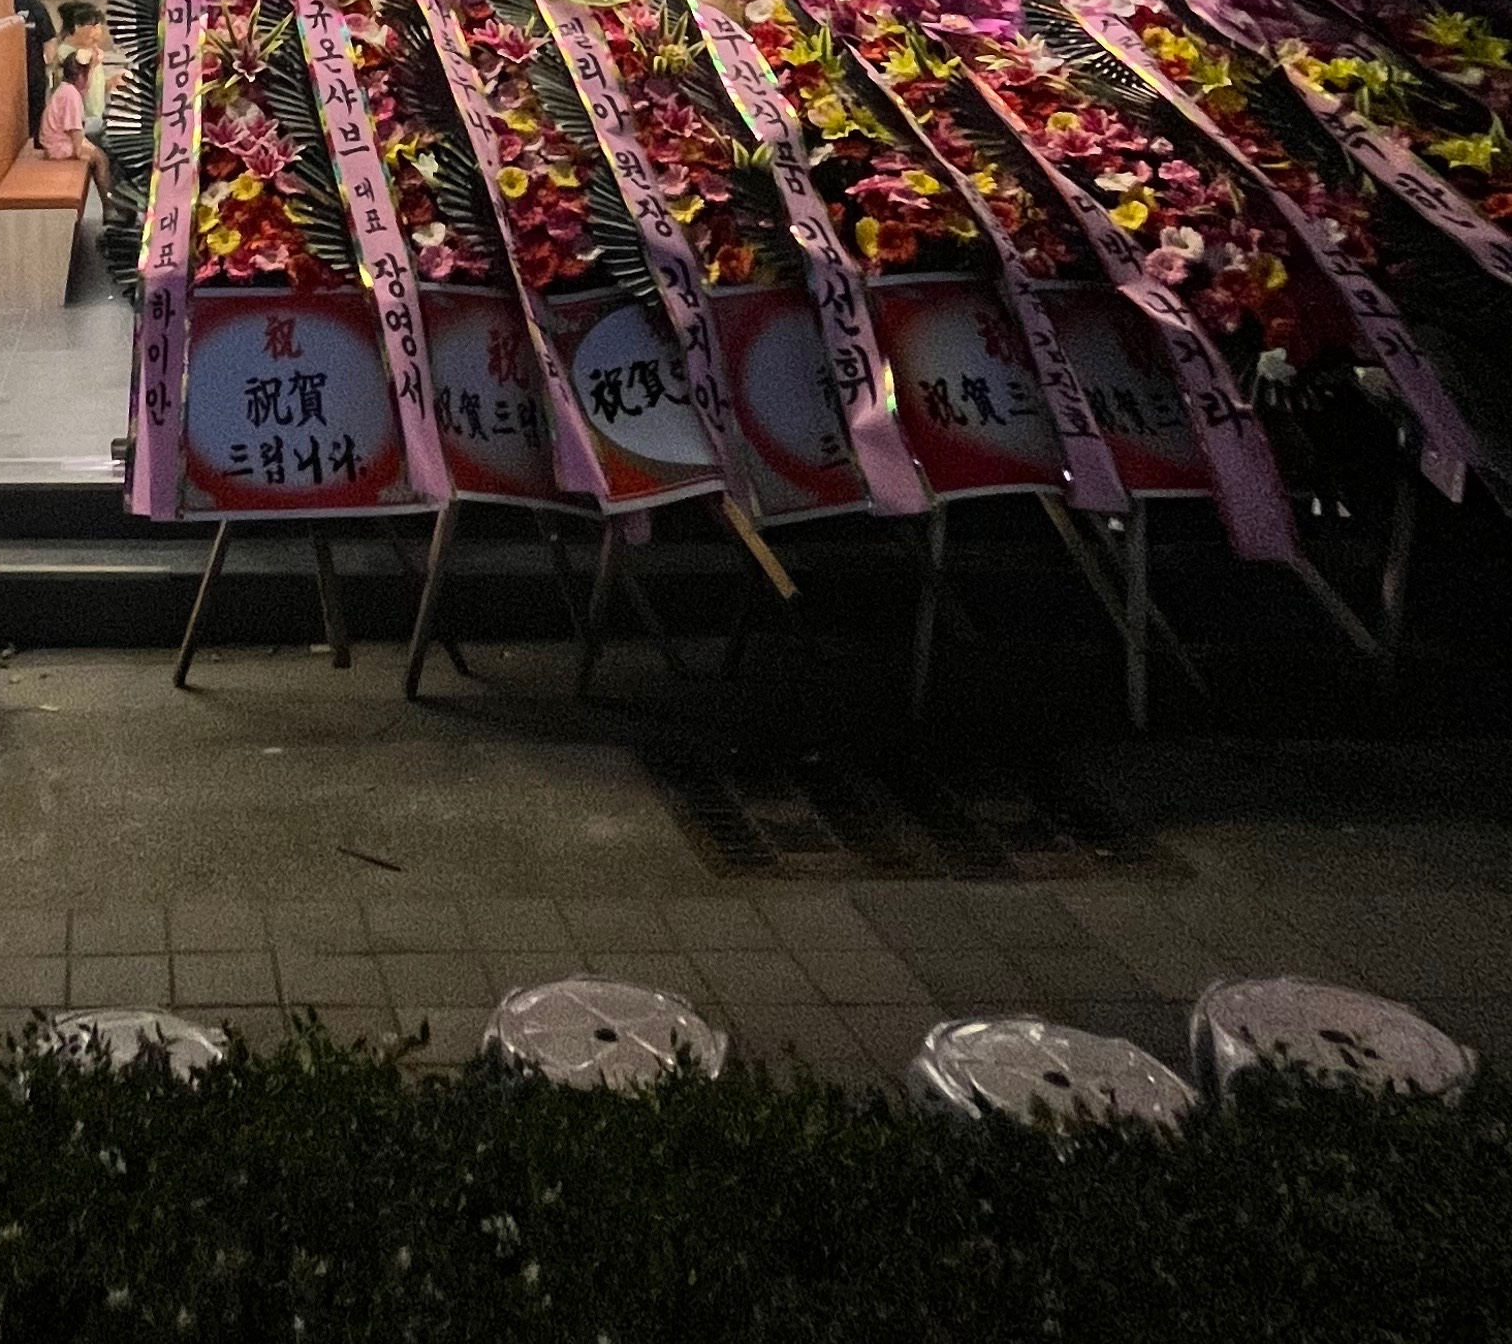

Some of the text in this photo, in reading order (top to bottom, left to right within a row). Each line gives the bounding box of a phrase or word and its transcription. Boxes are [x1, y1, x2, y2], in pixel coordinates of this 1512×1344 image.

[615, 150, 673, 238] 원장
[152, 214, 180, 270] 대표
[352, 180, 386, 235] 대표
[372, 254, 427, 421] 장영서
[243, 370, 329, 429] 祝賀
